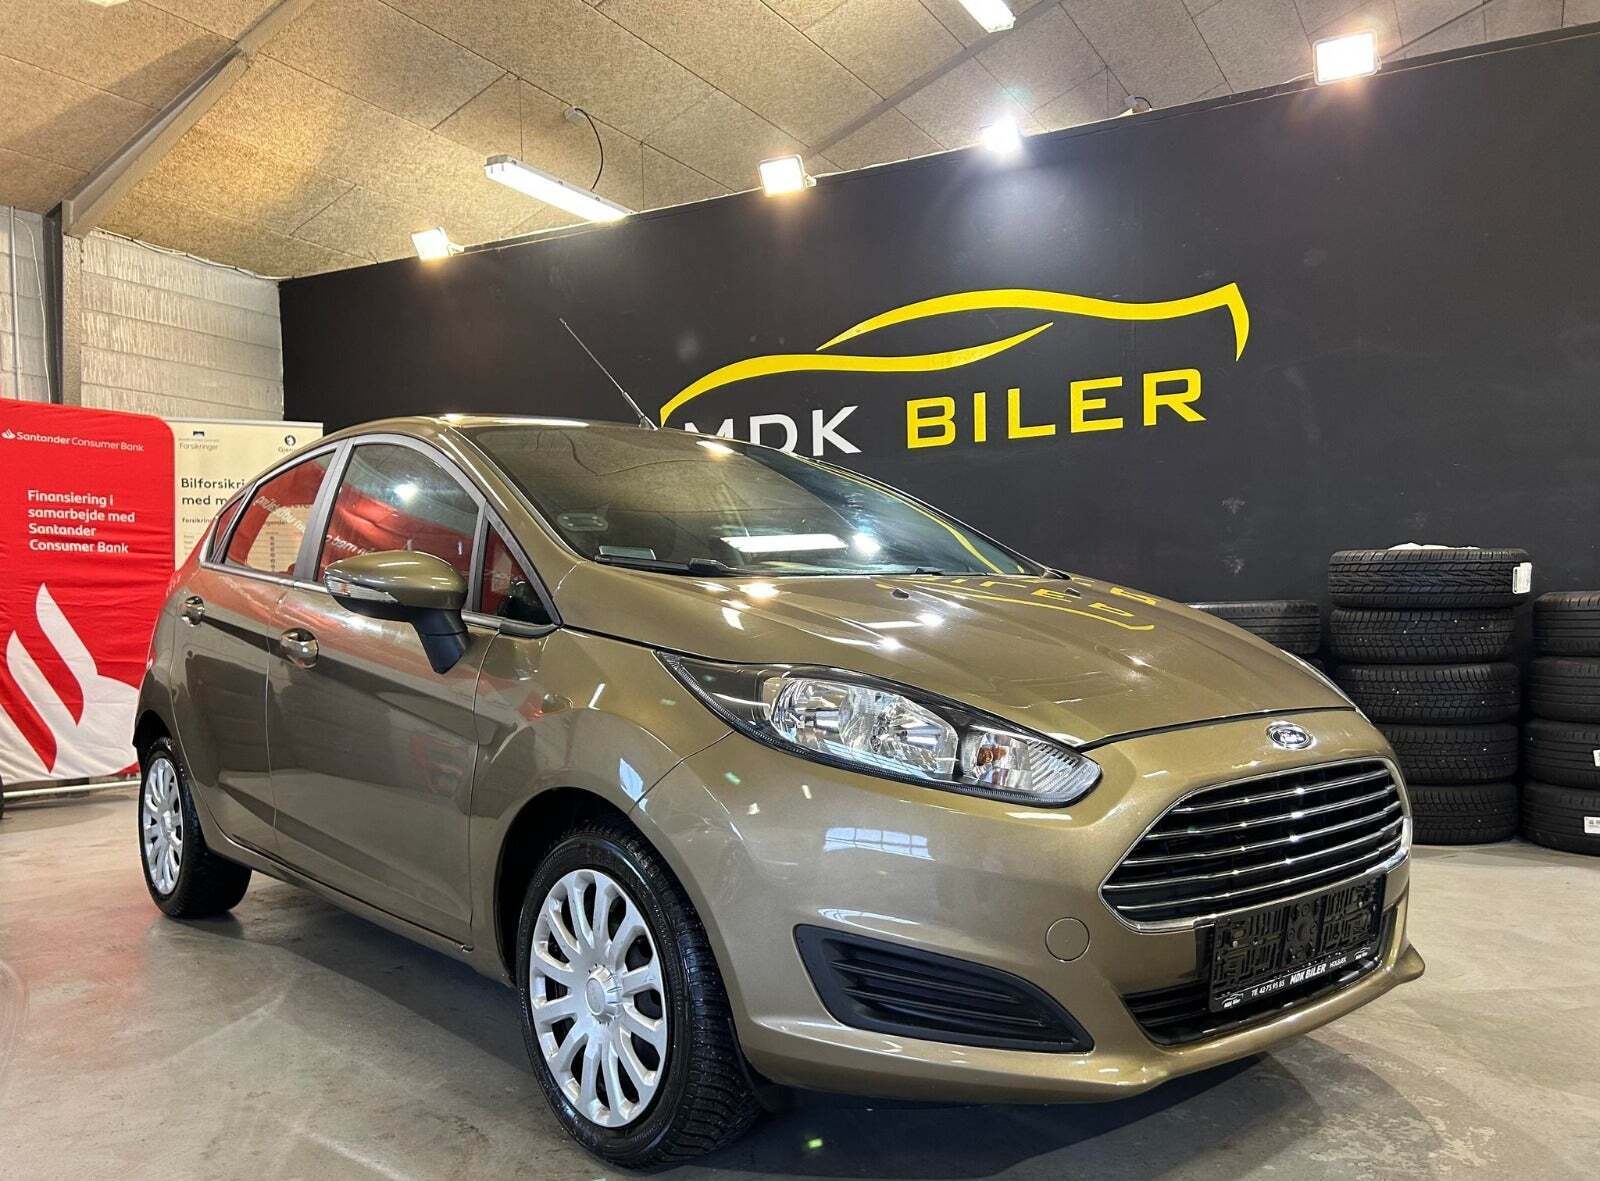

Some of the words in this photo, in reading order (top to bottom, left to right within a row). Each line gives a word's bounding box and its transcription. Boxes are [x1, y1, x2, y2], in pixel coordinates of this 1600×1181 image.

[906, 367, 1206, 449] BILER
[16, 431, 71, 445] Santander
[71, 437, 121, 449] Consumer
[121, 441, 145, 452] Bank
[181, 477, 245, 490] Bilforsikri
[27, 489, 107, 508] Finansiering
[109, 494, 114, 506] i
[181, 494, 211, 505] med
[27, 508, 106, 523] samarbejde
[107, 511, 136, 523] med
[28, 522, 97, 537] Santander
[29, 538, 95, 552] Consumer
[96, 541, 129, 553] Bank
[1305, 963, 1327, 979] BILER
